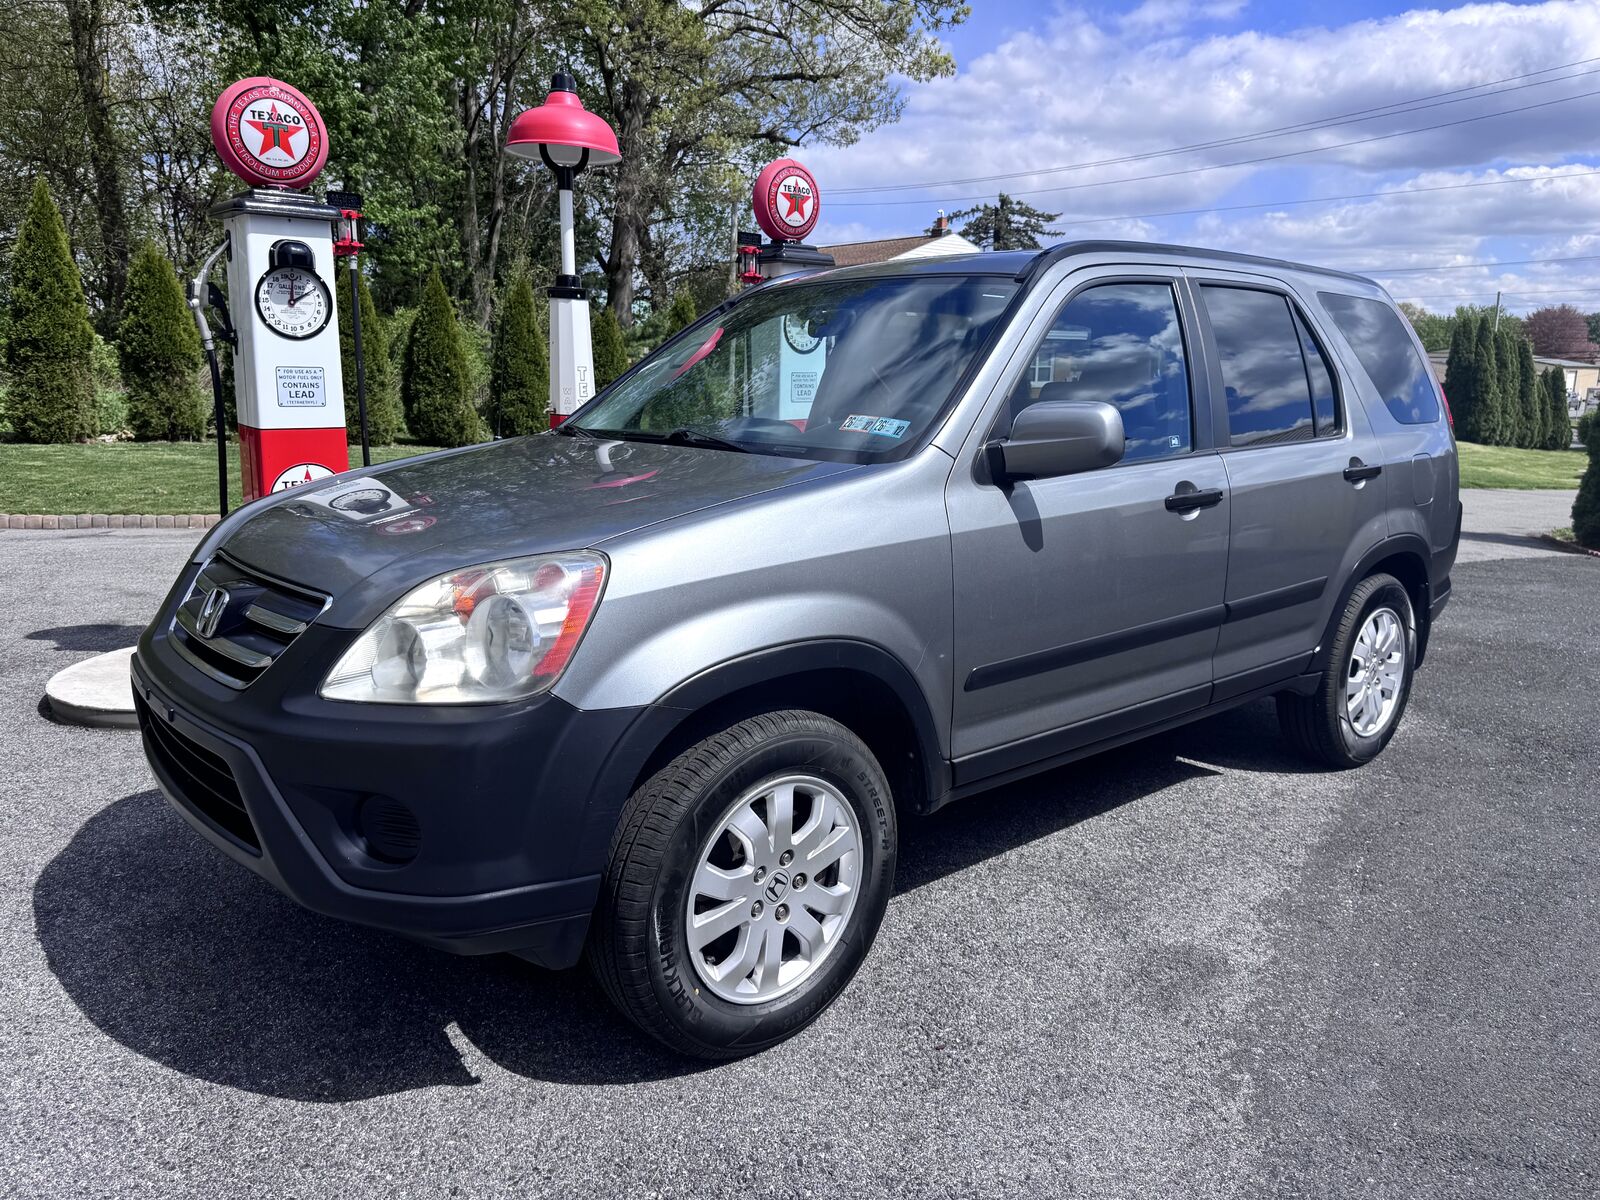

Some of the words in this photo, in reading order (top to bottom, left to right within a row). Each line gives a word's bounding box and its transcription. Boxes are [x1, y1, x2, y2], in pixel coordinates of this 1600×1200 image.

[229, 113, 238, 129] THE
[234, 90, 260, 108] TEXAS
[262, 89, 307, 112] COMPANY
[250, 110, 300, 125] TEXACO
[232, 137, 280, 177] PETROLEUM
[283, 147, 317, 177] PRODUCTS
[784, 184, 810, 194] TEXACO
[289, 390, 315, 398] LEAD
[282, 480, 308, 489] TE
